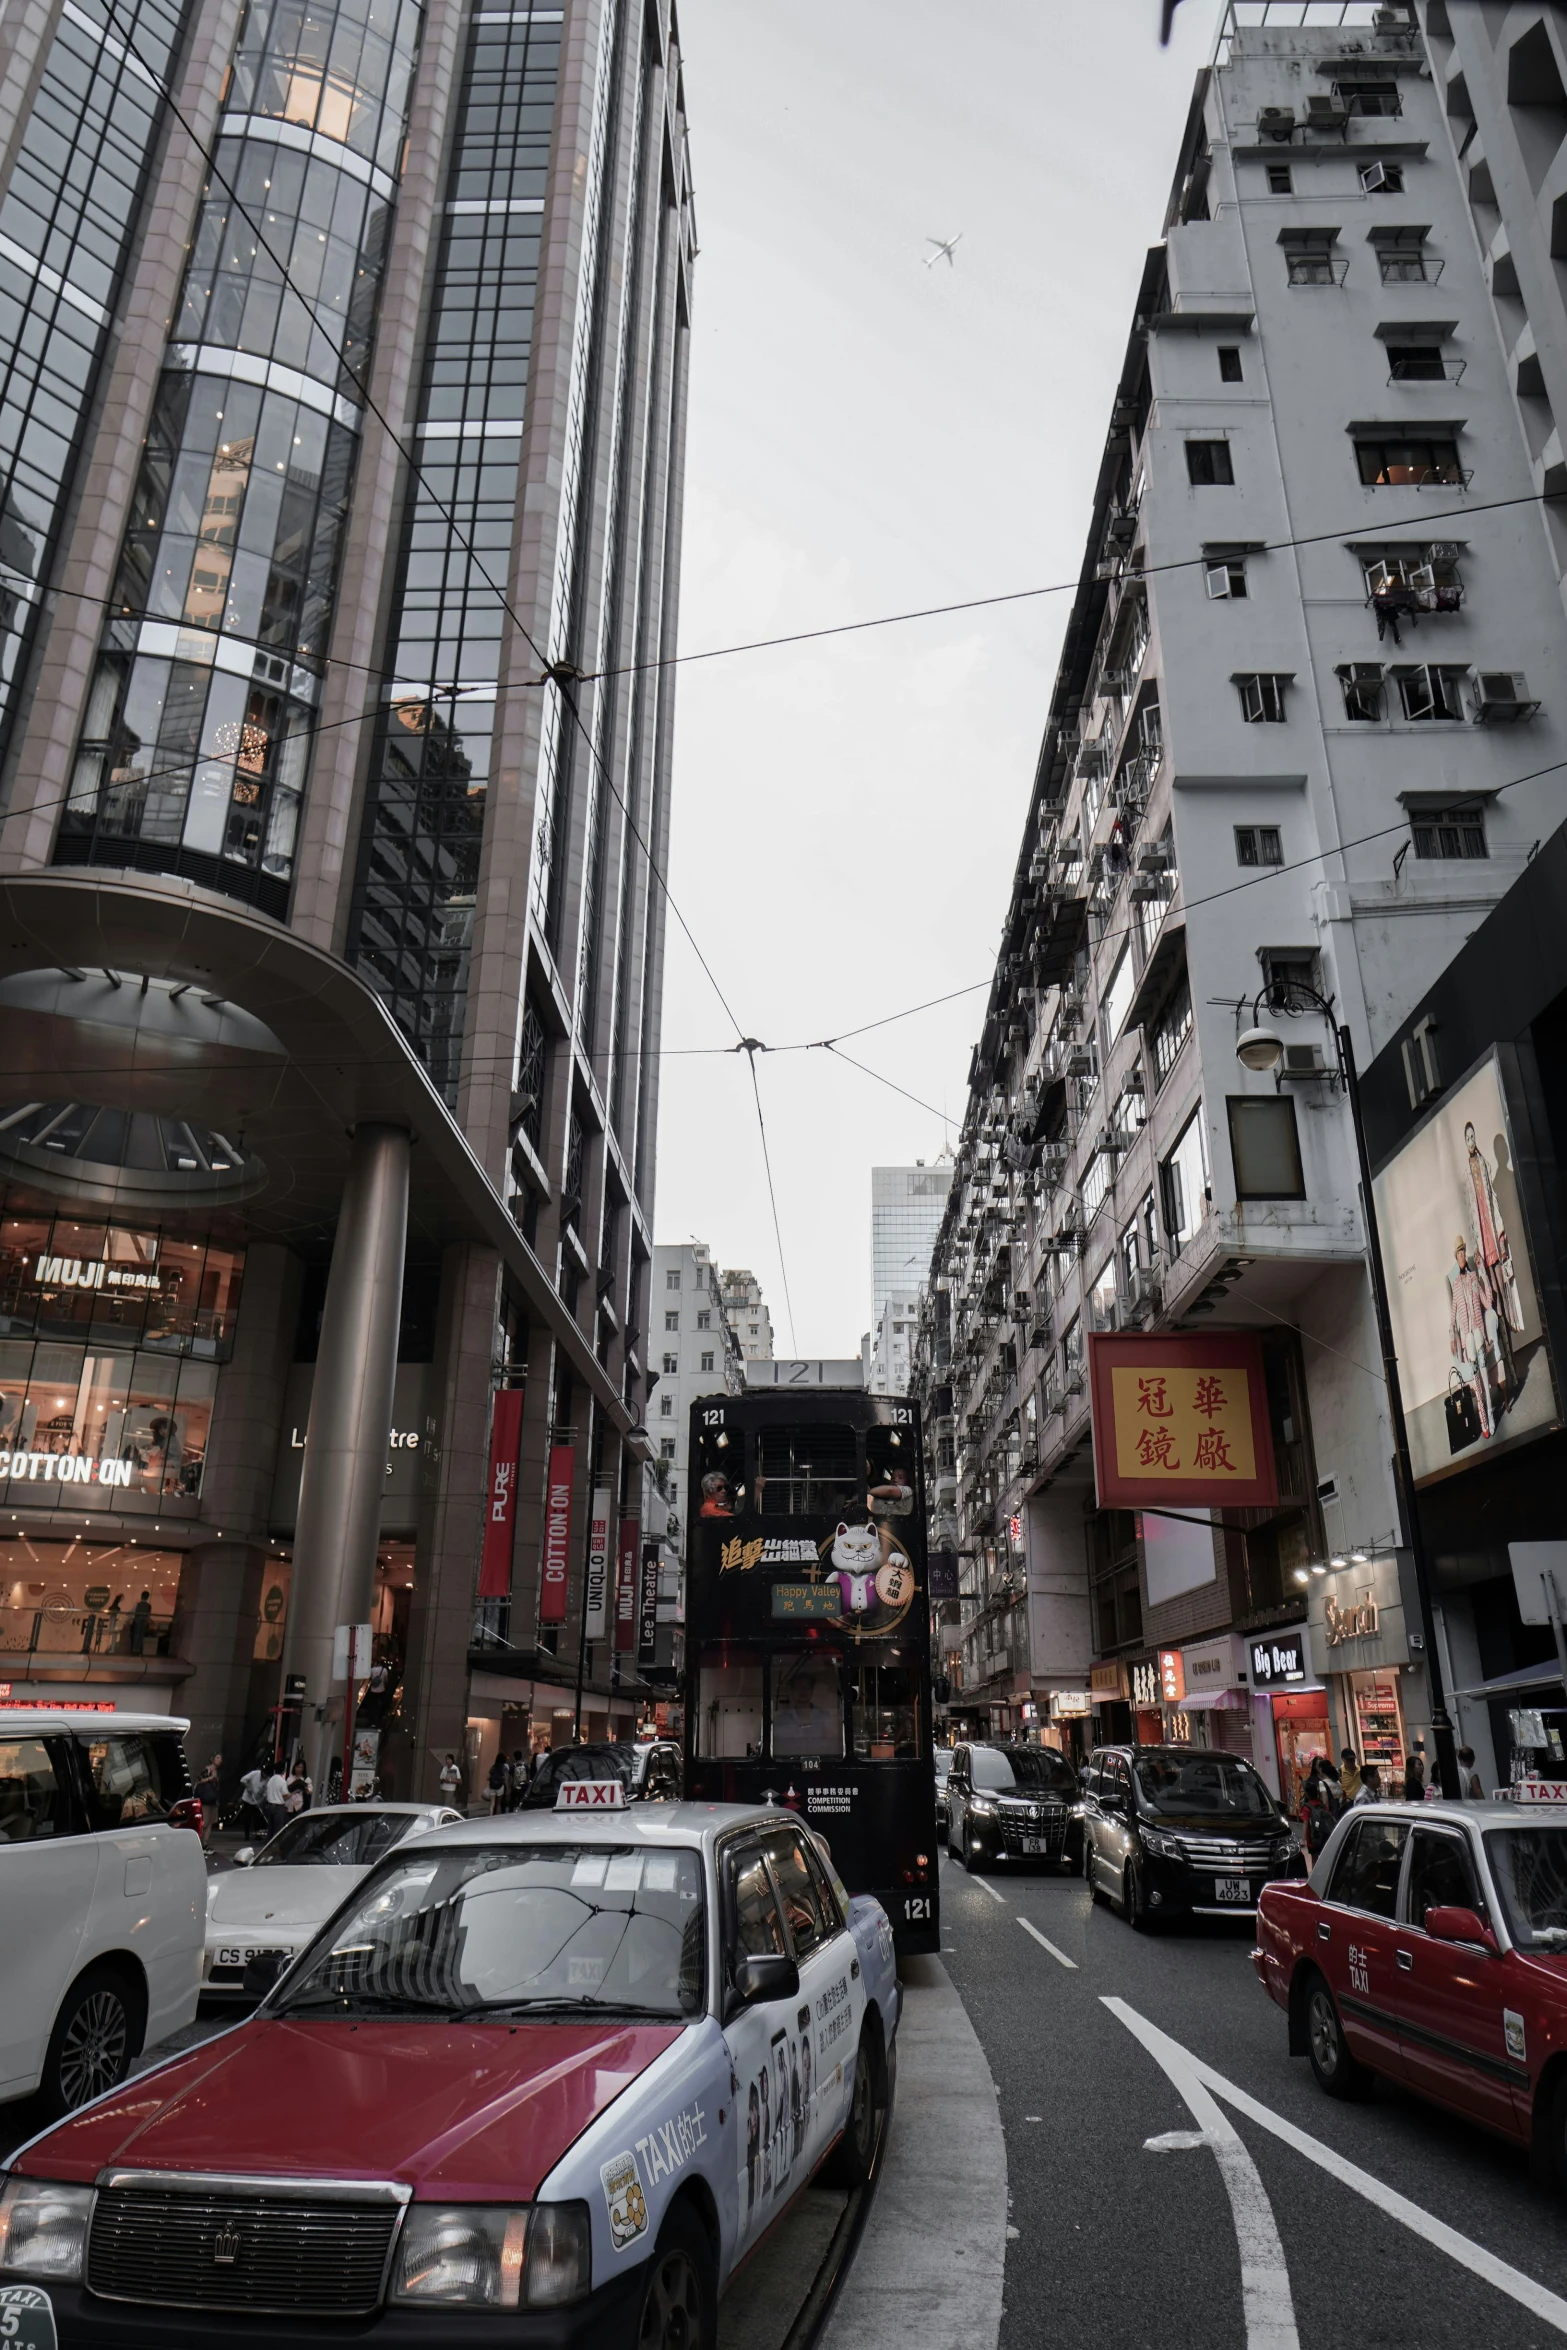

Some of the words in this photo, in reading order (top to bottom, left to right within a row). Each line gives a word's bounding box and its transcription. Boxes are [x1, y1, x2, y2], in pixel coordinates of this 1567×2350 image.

[35, 1256, 105, 1289] MUJI
[108, 1271, 160, 1289] 無印良品
[773, 1361, 823, 1384] 121
[1136, 1375, 1229, 1420] 冠華
[702, 1408, 725, 1426] 121
[891, 1408, 913, 1424] 121
[1134, 1426, 1238, 1472] 鏡廠
[492, 1462, 510, 1522] PURE
[588, 1555, 606, 1611] UNIQLO
[642, 1560, 657, 1616] Theatre
[776, 1586, 807, 1599] Happy
[811, 1586, 841, 1599] Valley
[619, 1585, 634, 1620] MUJI
[783, 1600, 836, 1612] 跑馬地
[641, 1620, 654, 1647] Lee
[1254, 1645, 1271, 1680] Big
[1272, 1646, 1297, 1673] Bear
[1366, 1701, 1395, 1710] Supreme
[803, 1760, 819, 1769] 104
[562, 1785, 615, 1804] TAXI
[807, 1796, 851, 1805] COMPETITION
[807, 1805, 851, 1813] COMMISSION
[1218, 1889, 1249, 1900] 4023
[1225, 1880, 1240, 1891] UW
[904, 1898, 931, 1920] 121
[219, 1949, 240, 1964] CS
[1349, 1943, 1368, 1968] 的士
[1349, 1965, 1370, 1995] TAXI
[634, 2119, 685, 2188] TAXI
[677, 2101, 708, 2159] 的士
[0, 2290, 42, 2309] TAXI
[0, 2306, 23, 2337] 5
